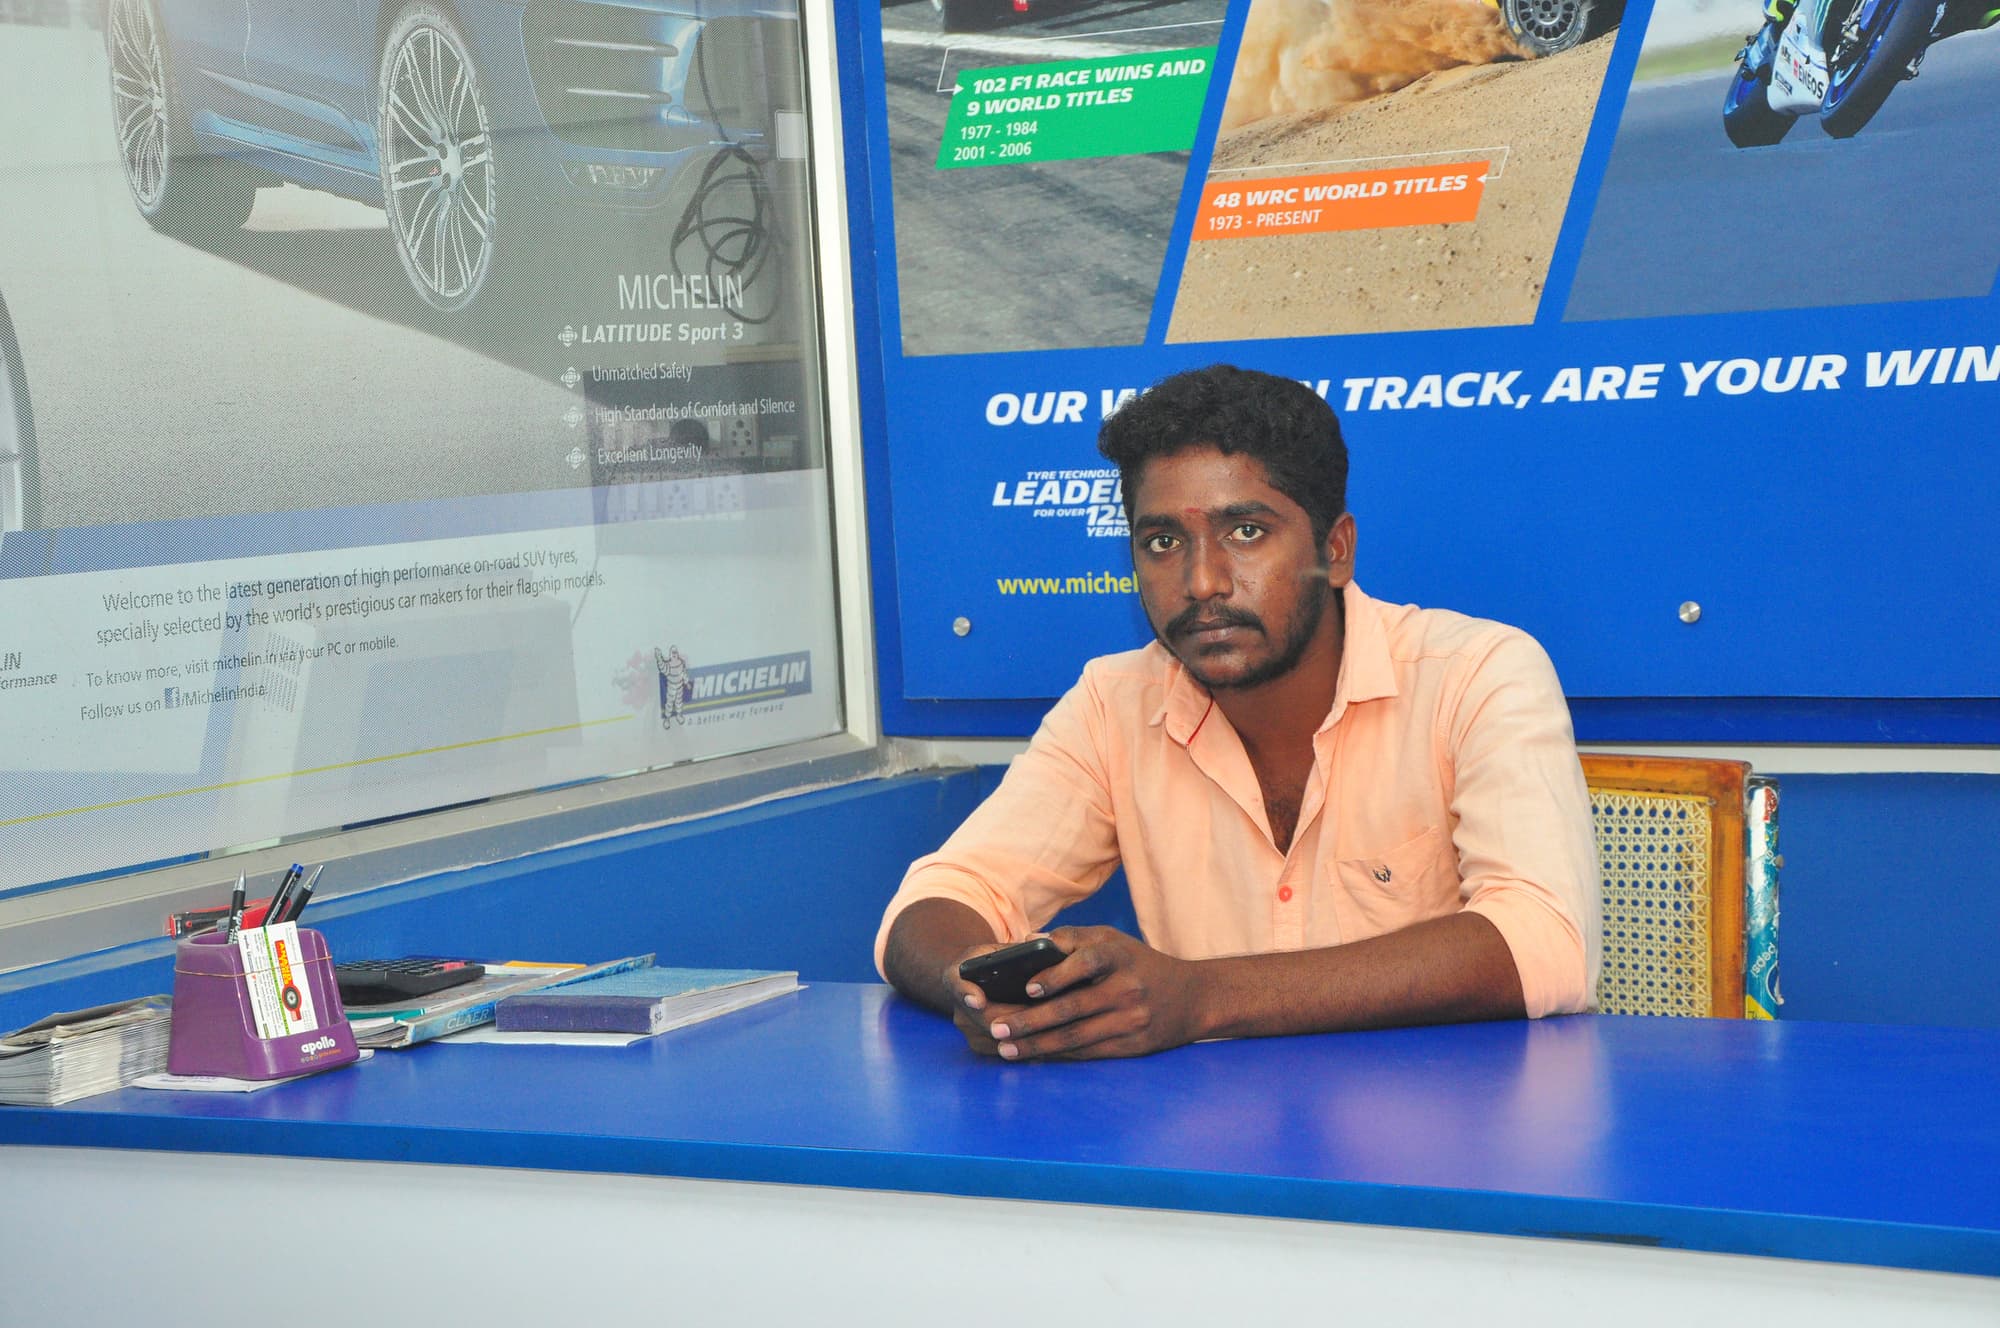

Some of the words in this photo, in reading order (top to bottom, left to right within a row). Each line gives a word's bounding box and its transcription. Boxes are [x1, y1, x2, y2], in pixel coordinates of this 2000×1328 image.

[973, 78, 1006, 95] 102
[1010, 75, 1033, 91] F1
[1035, 69, 1090, 89] RACE
[1094, 63, 1153, 83] WINS
[1156, 59, 1206, 78] AND
[966, 101, 980, 117] 9
[984, 94, 1061, 115] WORLD
[1066, 87, 1133, 107] TITLES
[960, 124, 992, 140] 1977
[1005, 121, 1038, 137] 1984
[953, 146, 985, 162] 2001
[998, 141, 1032, 158] 2006
[1213, 191, 1241, 209] 48
[1246, 187, 1300, 206] WRC
[1304, 182, 1387, 203] WORLD
[1393, 174, 1468, 195] TITLES
[1208, 213, 1242, 231] 1973
[1256, 208, 1323, 227] PRESENT
[618, 273, 744, 310] MICHELIN
[581, 323, 672, 344] LATITUDE
[678, 322, 727, 345] Sport
[732, 322, 744, 340] 3
[592, 364, 657, 382] Unmatched
[659, 361, 692, 383] Safety
[1342, 370, 1532, 411] TRACK,
[1541, 363, 1664, 404] ARE
[1679, 353, 1847, 397] YOUR
[595, 406, 621, 426] High
[624, 401, 679, 421] Standards
[681, 400, 693, 417] of
[694, 399, 735, 417] Comfort
[735, 398, 758, 415] and
[759, 397, 796, 415] Silence
[985, 390, 1088, 426] OUR
[598, 446, 647, 465] Excellent
[649, 441, 702, 463] Longevity
[1026, 470, 1056, 480] TYRE
[1059, 469, 1122, 480] TECHNOLO
[1033, 509, 1055, 518] FOR
[1056, 508, 1085, 517] OVER
[102, 590, 173, 612] Welcome
[176, 589, 193, 605] to
[196, 584, 222, 602] the
[225, 580, 263, 600] latest
[266, 572, 340, 598] generation
[343, 568, 358, 586] of
[361, 566, 390, 589] high
[393, 560, 471, 586] performance
[473, 552, 520, 574] on-road
[522, 550, 545, 569] SUV
[548, 549, 578, 569] tyres,
[997, 571, 1140, 594] www.michel
[96, 620, 159, 647] specially
[163, 611, 222, 636] selected
[224, 611, 243, 632] by
[245, 606, 269, 627] the
[273, 601, 322, 623] world's
[325, 593, 395, 620] prestigious
[398, 594, 418, 610] car
[419, 586, 463, 607] makers
[466, 580, 484, 601] for
[486, 577, 514, 598] their
[516, 572, 562, 597] flagship
[87, 672, 103, 688] To
[105, 668, 142, 686] know
[145, 662, 182, 681] more,
[184, 657, 210, 675] visit
[279, 645, 296, 662] via
[298, 643, 325, 665] your
[327, 640, 342, 657] PC
[343, 640, 357, 655] or
[0, 673, 57, 690] ormance
[692, 660, 807, 700] MICHELIN
[80, 702, 124, 721] Follow
[127, 700, 142, 714] us
[144, 697, 161, 713] on
[301, 1036, 336, 1055] apollo
